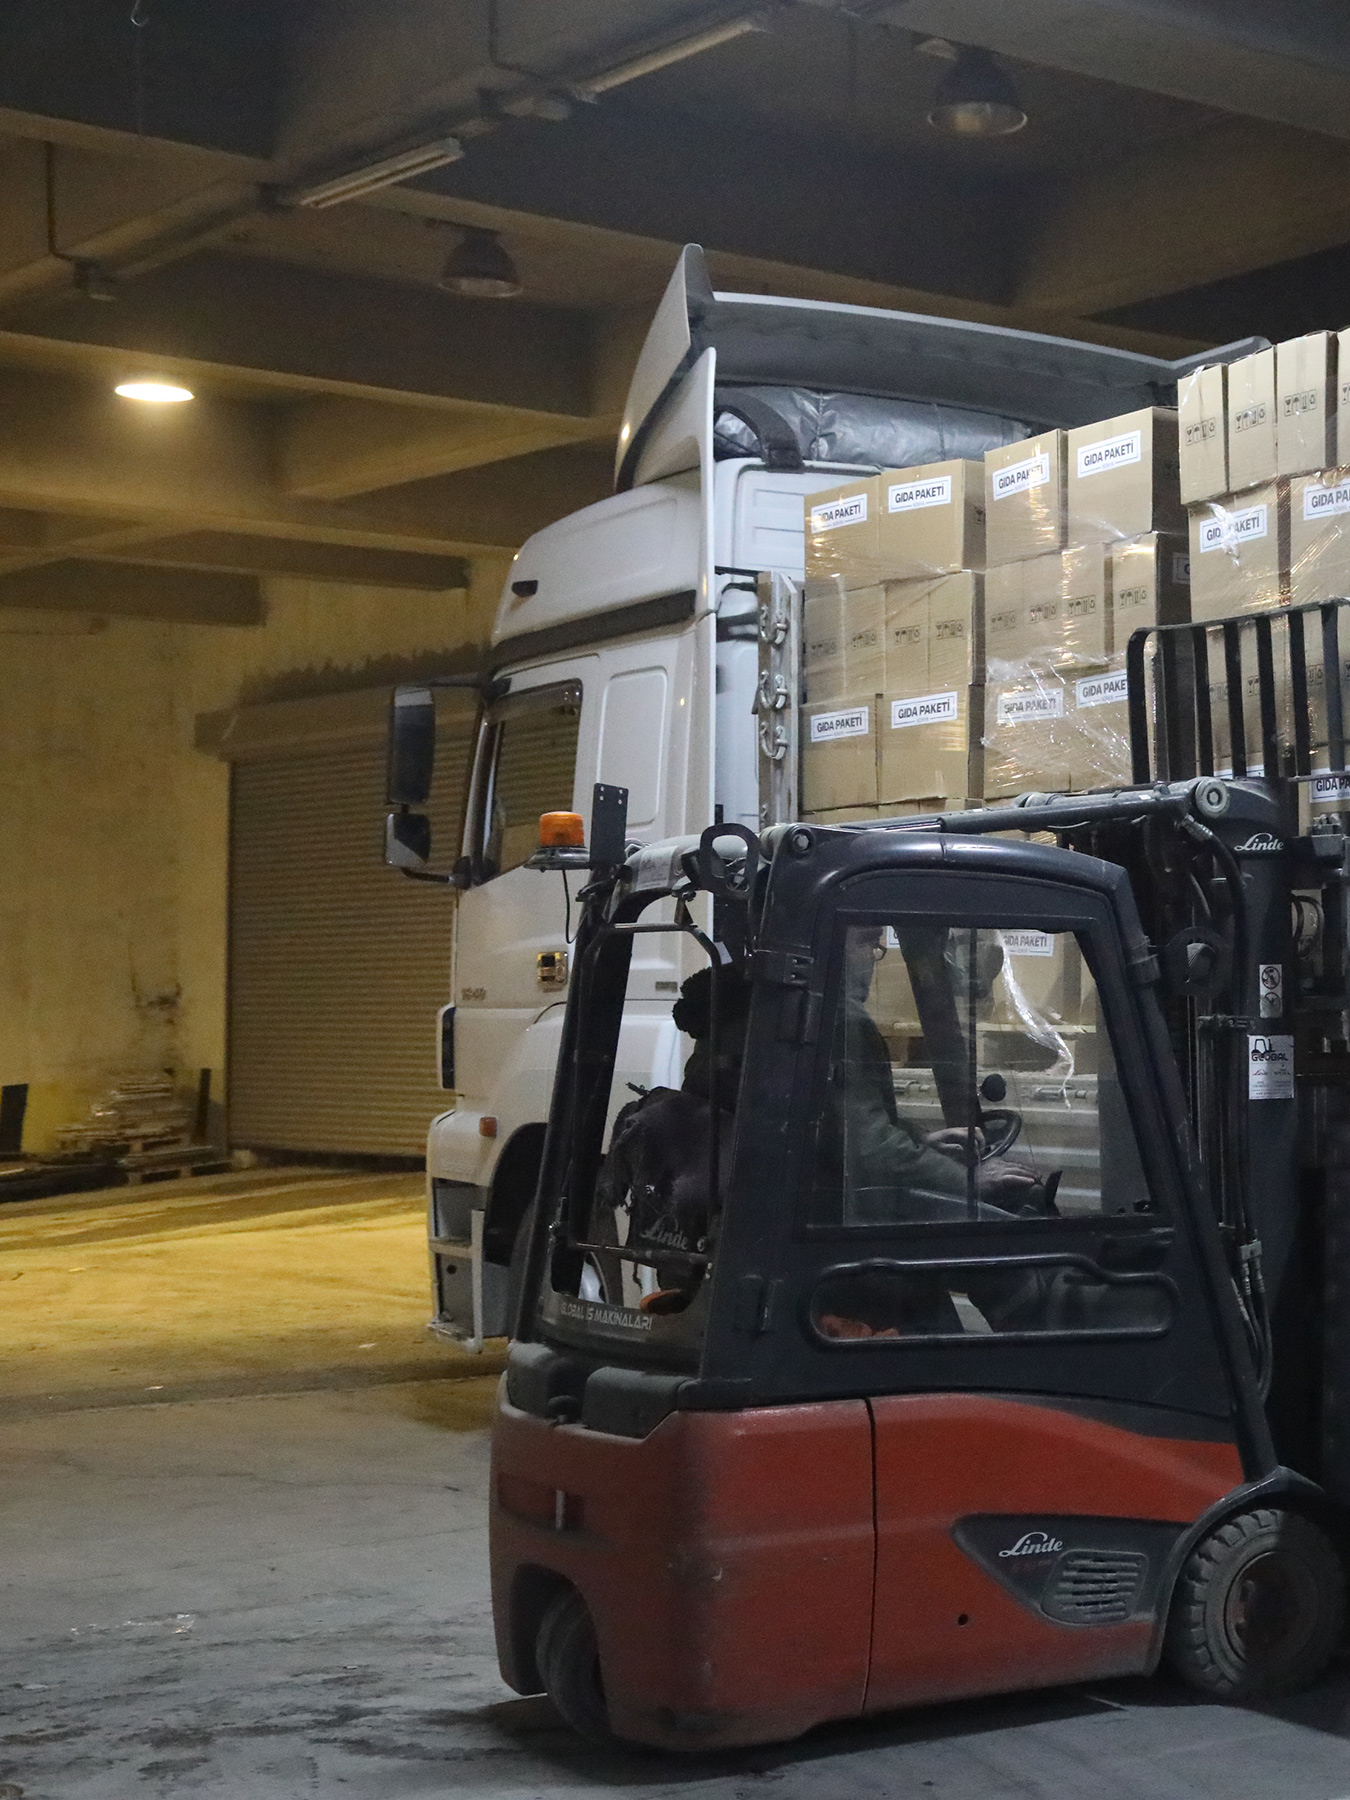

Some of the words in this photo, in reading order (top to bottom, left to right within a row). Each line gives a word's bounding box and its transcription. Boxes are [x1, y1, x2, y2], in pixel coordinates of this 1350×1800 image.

[1084, 451, 1103, 467] GIDA
[1104, 439, 1134, 461] PAKETİ
[998, 474, 1016, 489] GIDA
[895, 491, 914, 503] GIDA
[915, 483, 944, 500] PAKETİ
[1311, 492, 1334, 508] GIDA
[818, 511, 834, 521] IDA
[835, 501, 861, 519] PAKETİ
[1206, 526, 1223, 541] GID
[1230, 513, 1260, 533] AKETİ
[1082, 684, 1102, 698] GIDA
[1103, 679, 1127, 693] PAKE
[898, 706, 918, 719] GIDA
[919, 698, 950, 716] PAKETİ
[816, 721, 834, 733] GIDA
[835, 713, 862, 730] PAKETİ
[1316, 777, 1338, 792] GIDA
[1233, 832, 1284, 852] Linde
[1251, 1053, 1289, 1062] GLOBAL
[639, 1213, 688, 1250] Linde
[999, 1531, 1063, 1558] Linde
